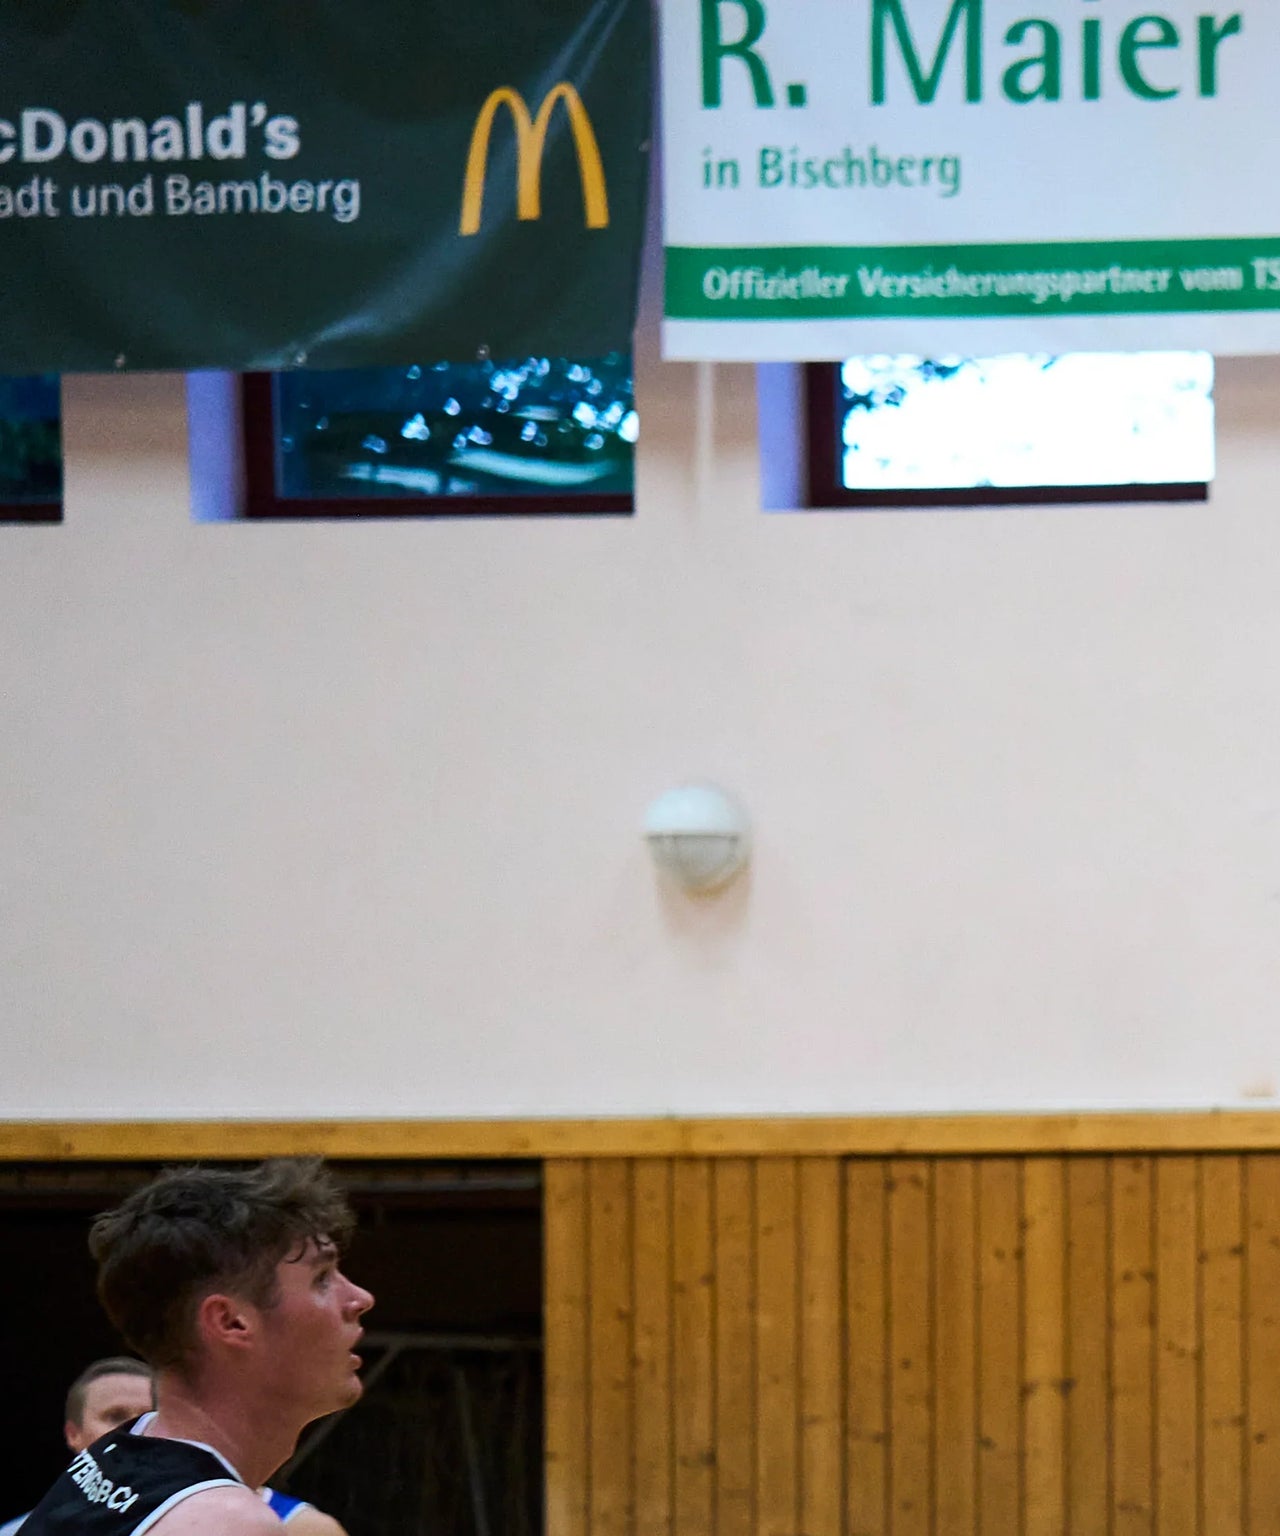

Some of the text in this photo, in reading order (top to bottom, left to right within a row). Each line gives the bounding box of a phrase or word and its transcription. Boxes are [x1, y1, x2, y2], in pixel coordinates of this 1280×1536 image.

[700, 0, 1242, 108] R. Maier
[72, 174, 153, 217] und
[165, 170, 361, 222] Bamberg
[702, 146, 962, 197] in Bischberg
[702, 264, 849, 301] Offizieller
[857, 263, 1172, 304] Versicherungspartner
